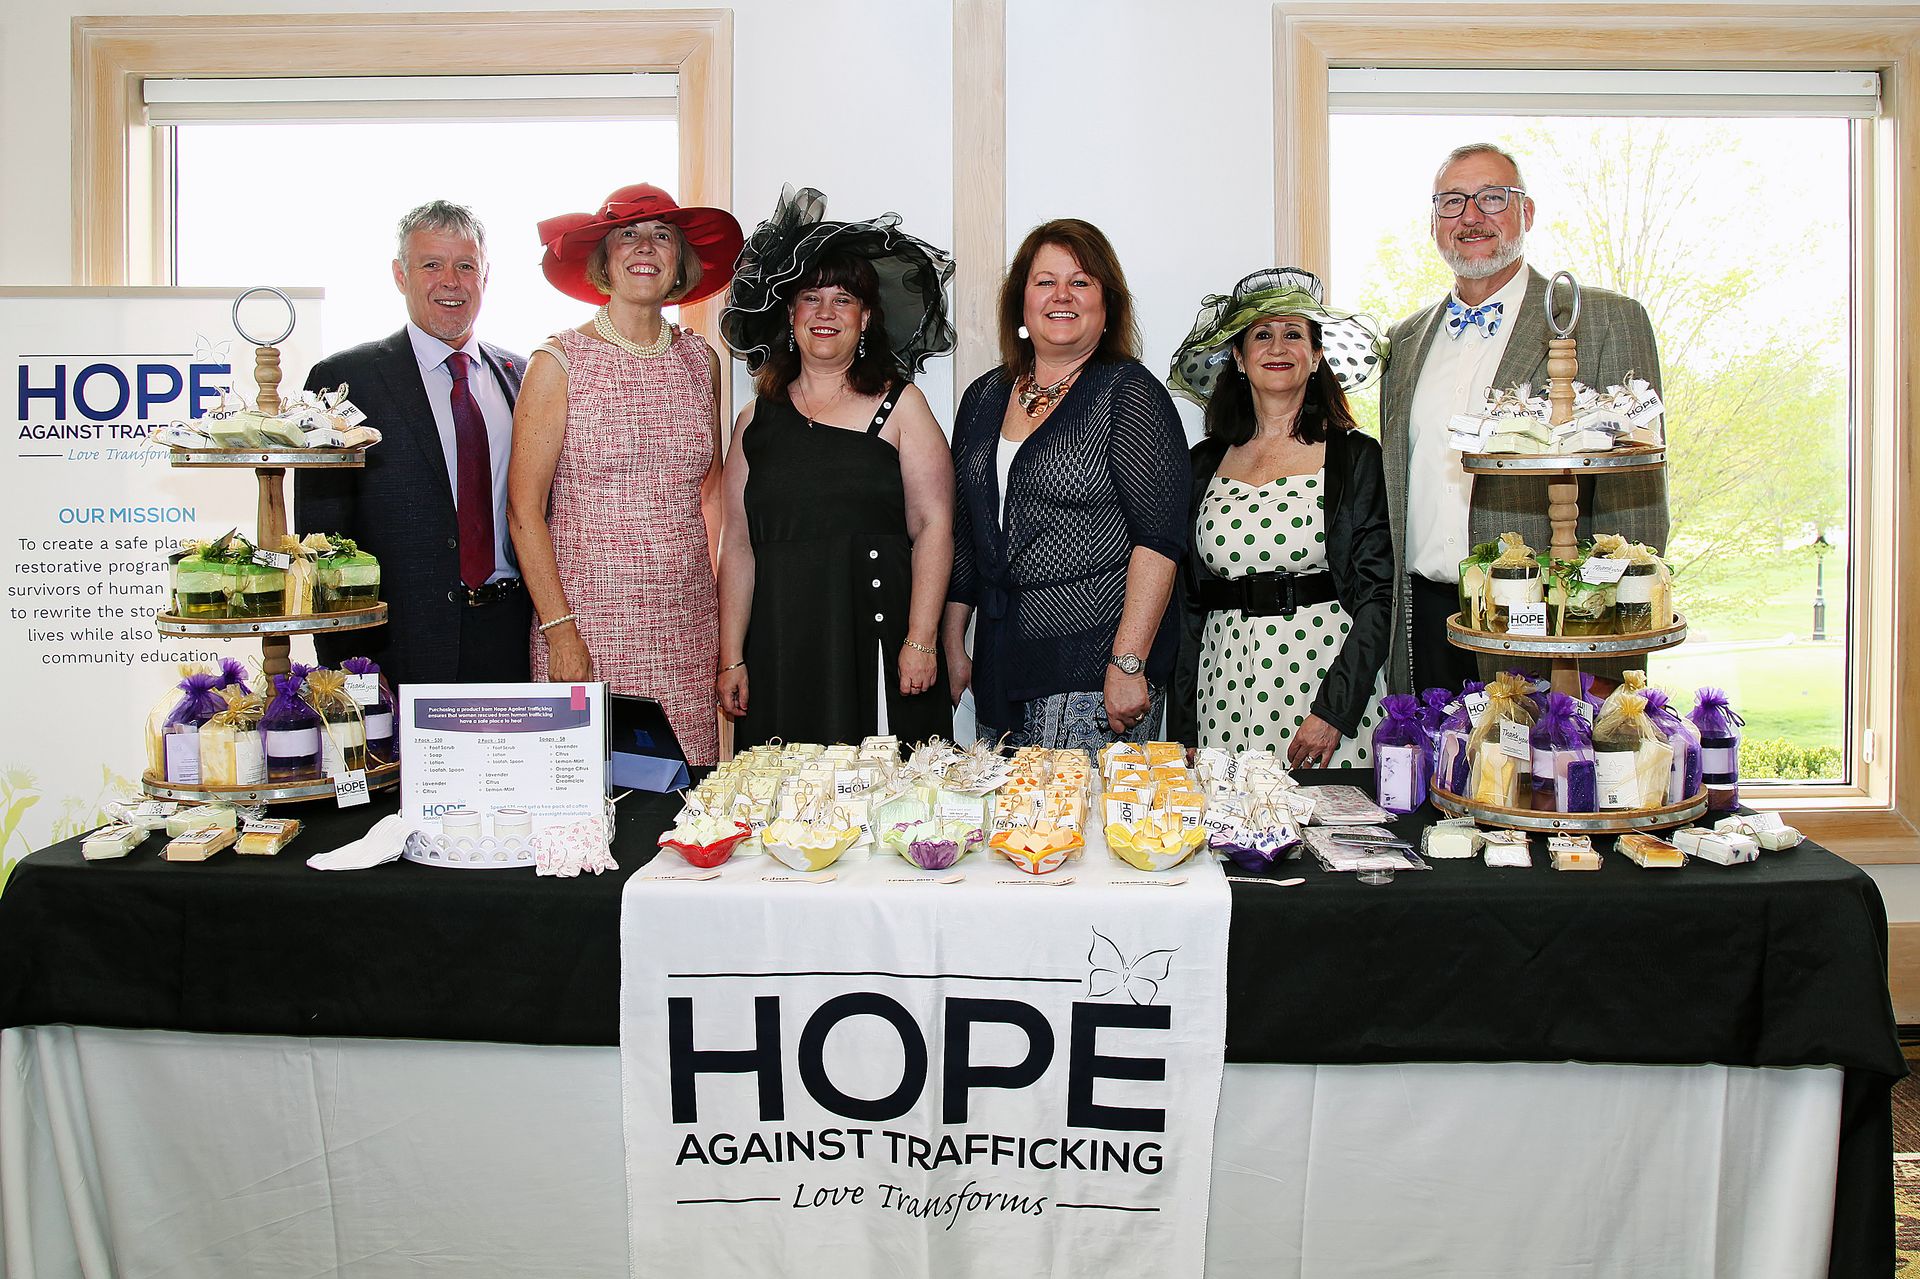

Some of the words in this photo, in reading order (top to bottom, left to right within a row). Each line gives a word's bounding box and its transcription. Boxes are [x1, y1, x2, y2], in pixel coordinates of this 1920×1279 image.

[18, 363, 232, 421] HOPE
[1626, 396, 1658, 418] HOPE
[18, 424, 106, 440] AGAINST
[68, 448, 100, 461] Love
[106, 445, 171, 468] Transfor
[58, 508, 105, 524] OUR
[110, 507, 196, 523] MISSION
[18, 538, 36, 550] To
[42, 538, 94, 550] create
[100, 540, 110, 550] a
[114, 536, 148, 550] safe
[15, 560, 102, 574] restorative
[8, 583, 81, 596] survivors
[87, 582, 104, 595] of
[109, 582, 164, 595] human
[10, 607, 27, 619] to
[33, 606, 92, 618] rewrite
[98, 605, 124, 618] the
[1510, 614, 1544, 624] HOPE
[28, 628, 64, 642] lives
[70, 628, 114, 641] while
[120, 627, 153, 640] also
[42, 650, 134, 666] community
[140, 649, 218, 662] education
[346, 682, 366, 690] Thank
[366, 684, 377, 693] you
[1502, 728, 1519, 740] Thank
[336, 780, 366, 793] HOPE
[667, 991, 1172, 1132] HOPE
[675, 1128, 873, 1166] AGAINST
[883, 1131, 1164, 1175] TRAFFICKING
[792, 1182, 865, 1210] Love
[878, 1180, 1048, 1232] Transforms
